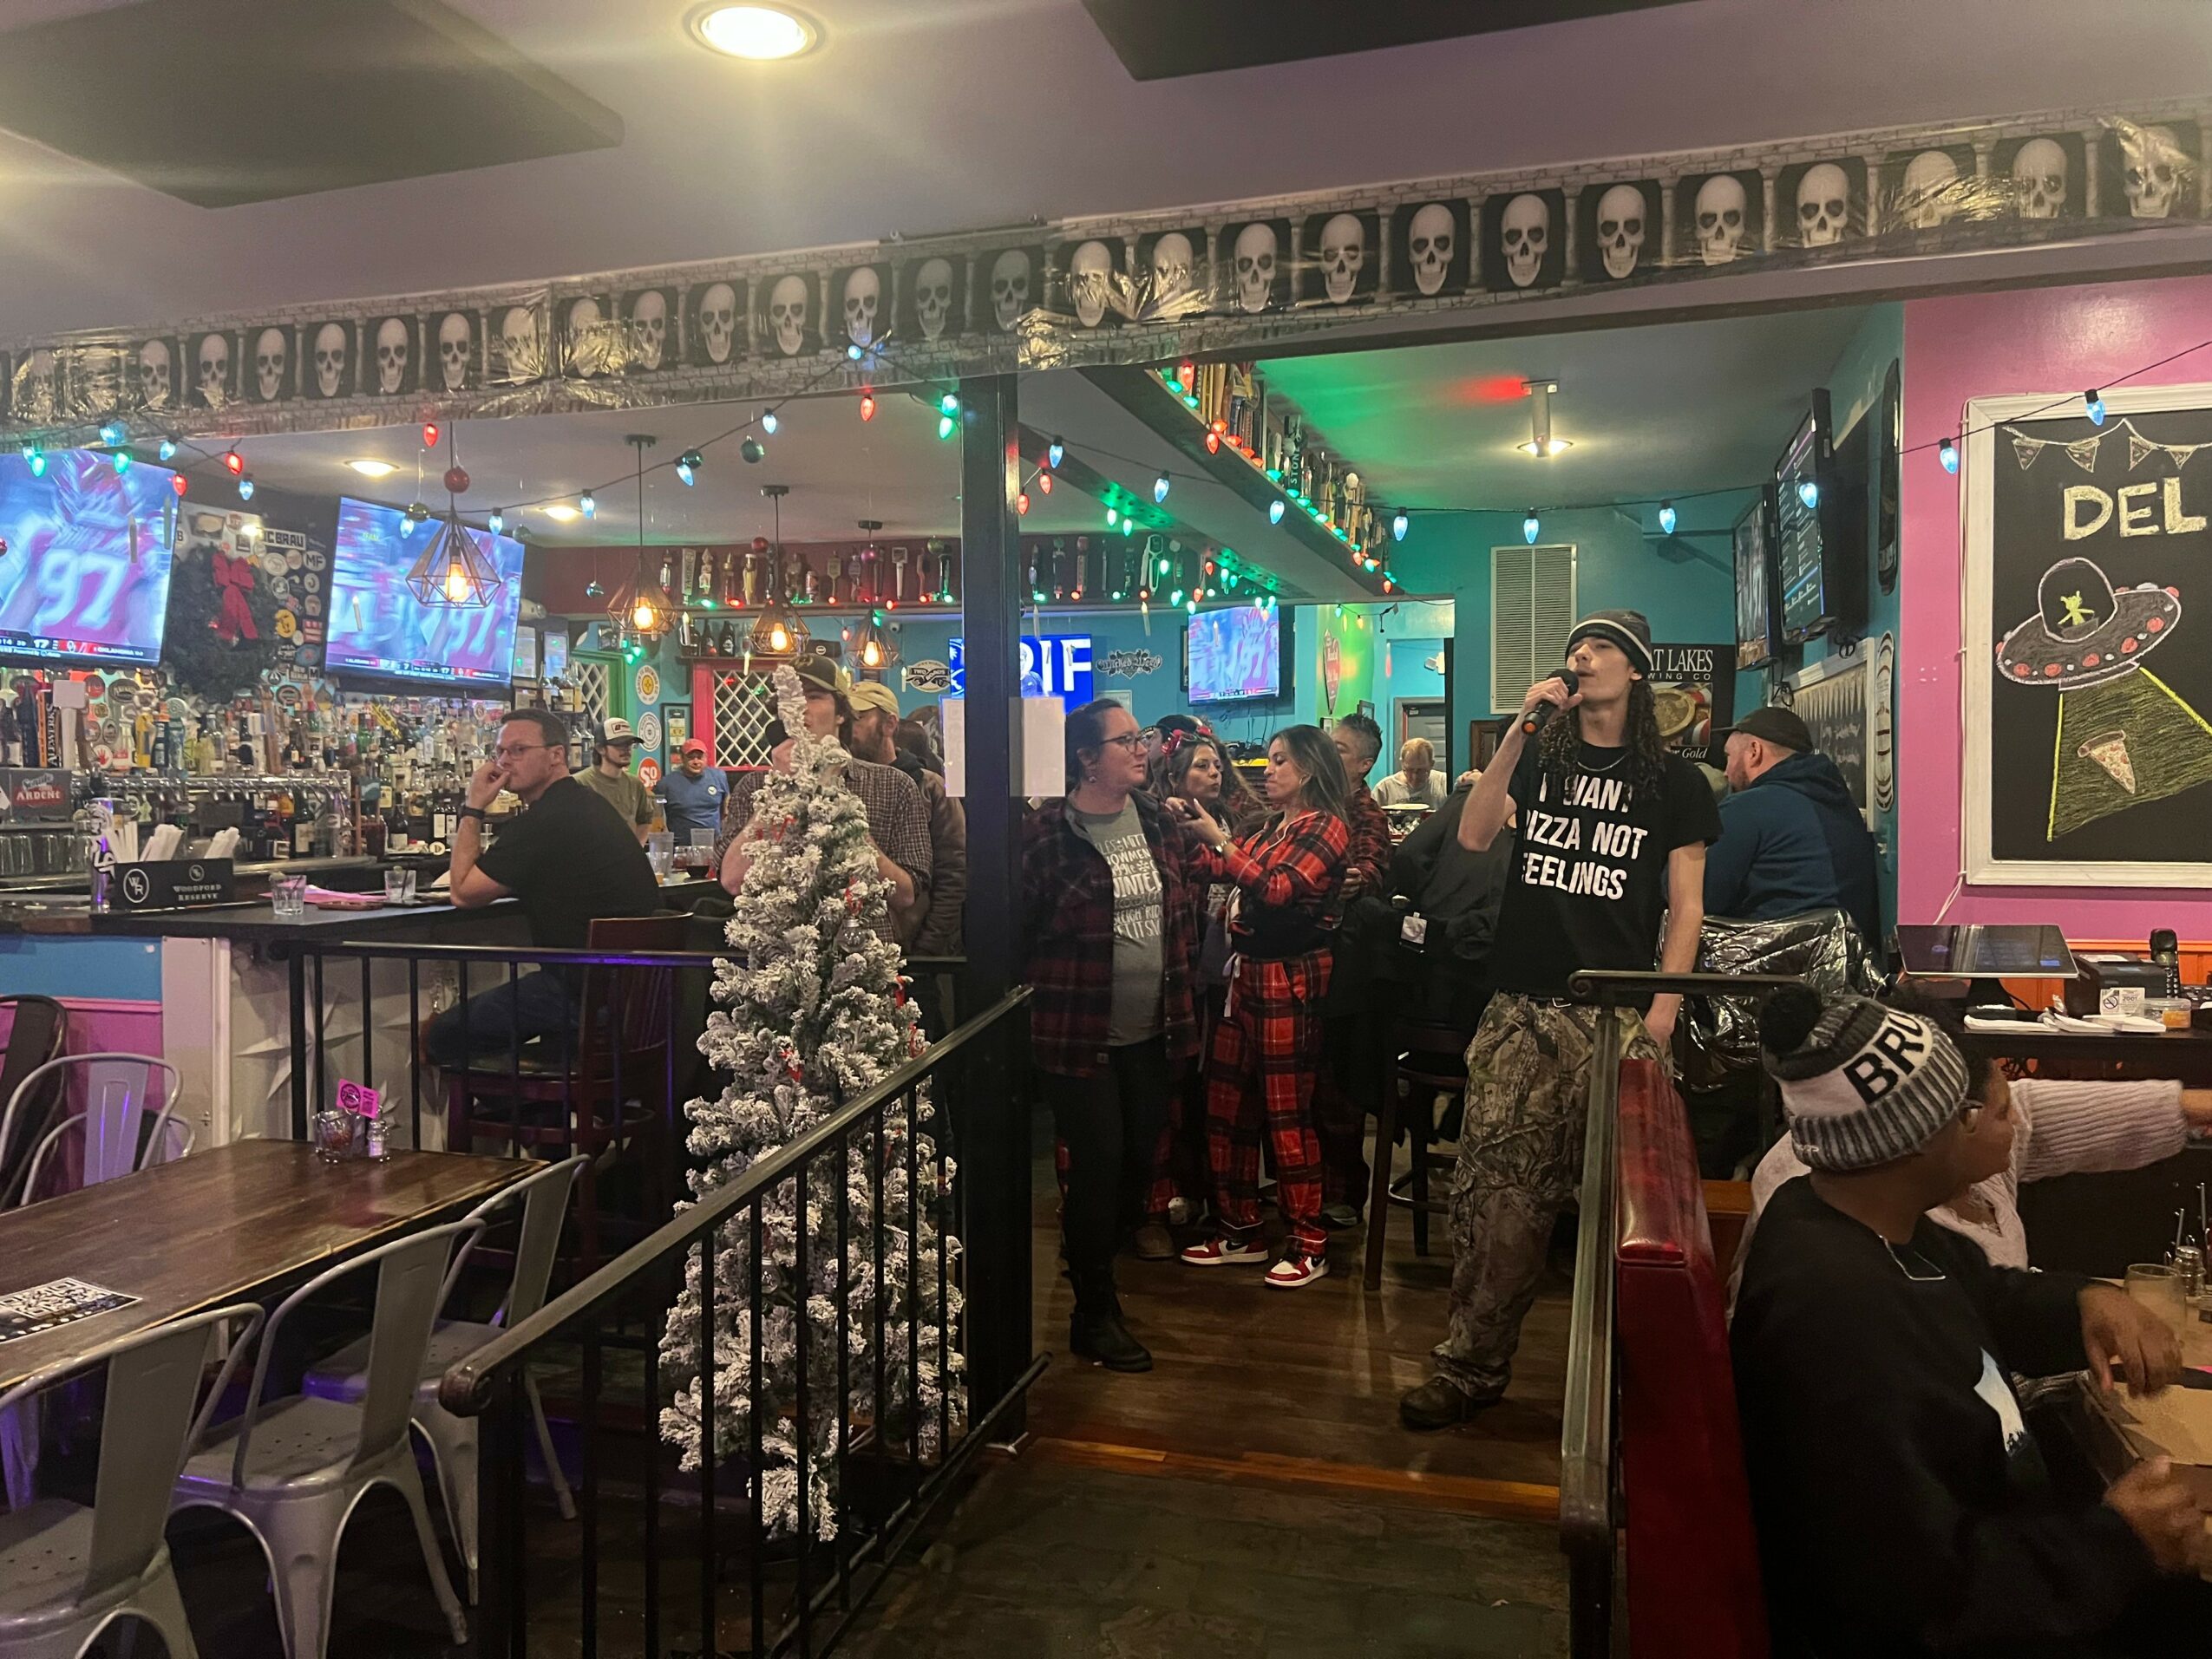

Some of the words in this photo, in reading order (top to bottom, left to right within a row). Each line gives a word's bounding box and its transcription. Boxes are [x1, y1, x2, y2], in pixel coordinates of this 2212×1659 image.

[2064, 476, 2208, 540] DEL
[34, 638, 49, 649] 17
[1666, 649, 1714, 672] LAKES
[1681, 747, 1708, 759] Gold
[1539, 772, 1548, 803] I
[1592, 821, 1648, 859] NOT
[1522, 852, 1627, 900] EELINGS
